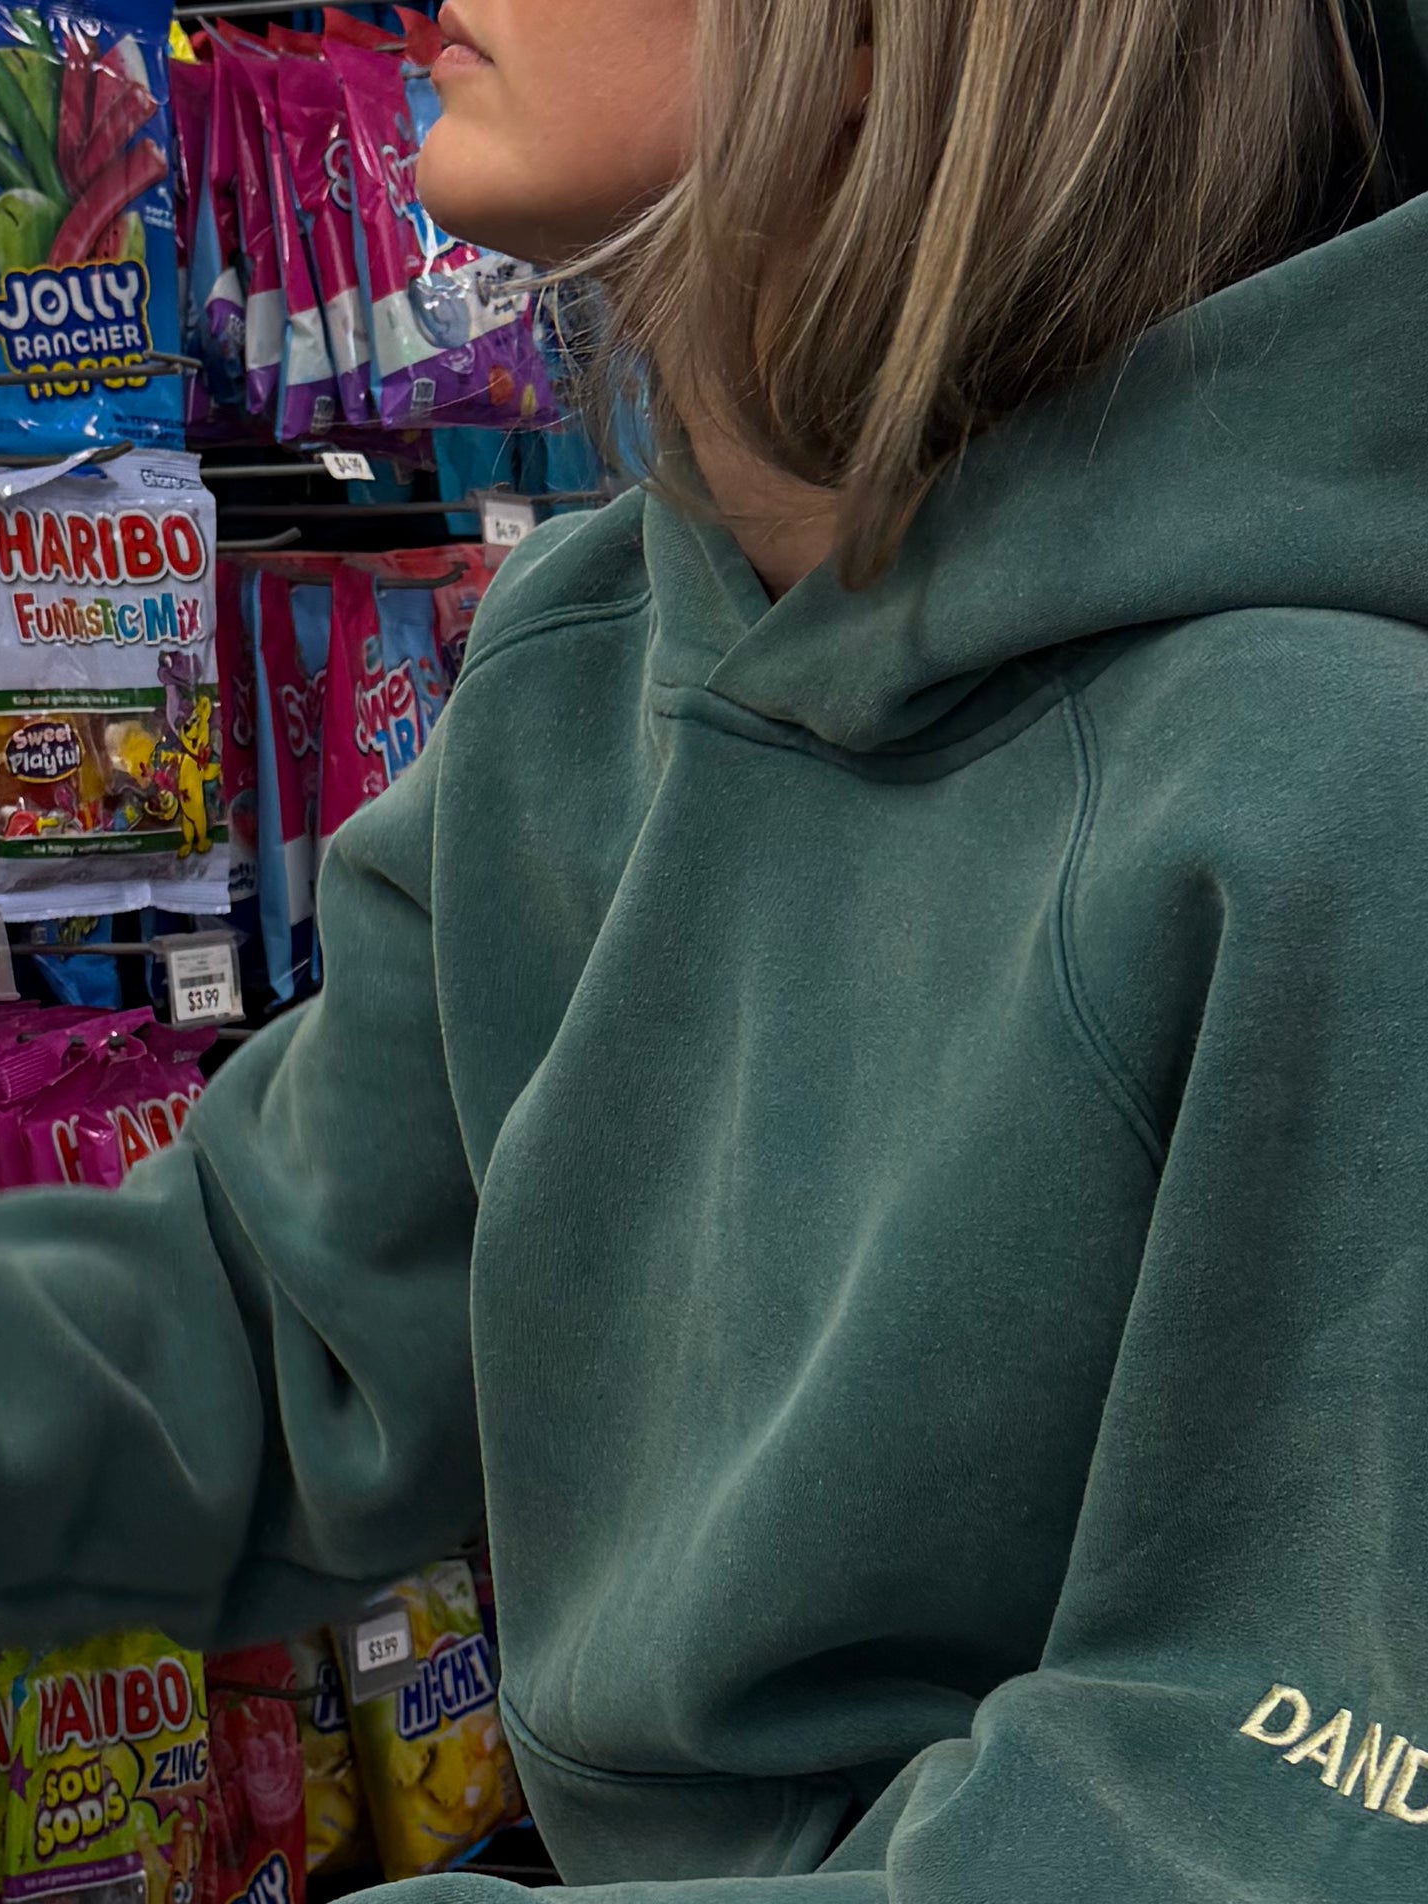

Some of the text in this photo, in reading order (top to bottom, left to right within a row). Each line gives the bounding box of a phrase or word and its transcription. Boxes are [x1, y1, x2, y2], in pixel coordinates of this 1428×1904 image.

[13, 325, 142, 362] RANCHER
[11, 720, 72, 750] Sweet
[7, 745, 83, 781] Playful
[185, 987, 220, 1013] $3.99
[368, 1636, 399, 1661] $3.99
[149, 1741, 207, 1791] ZING
